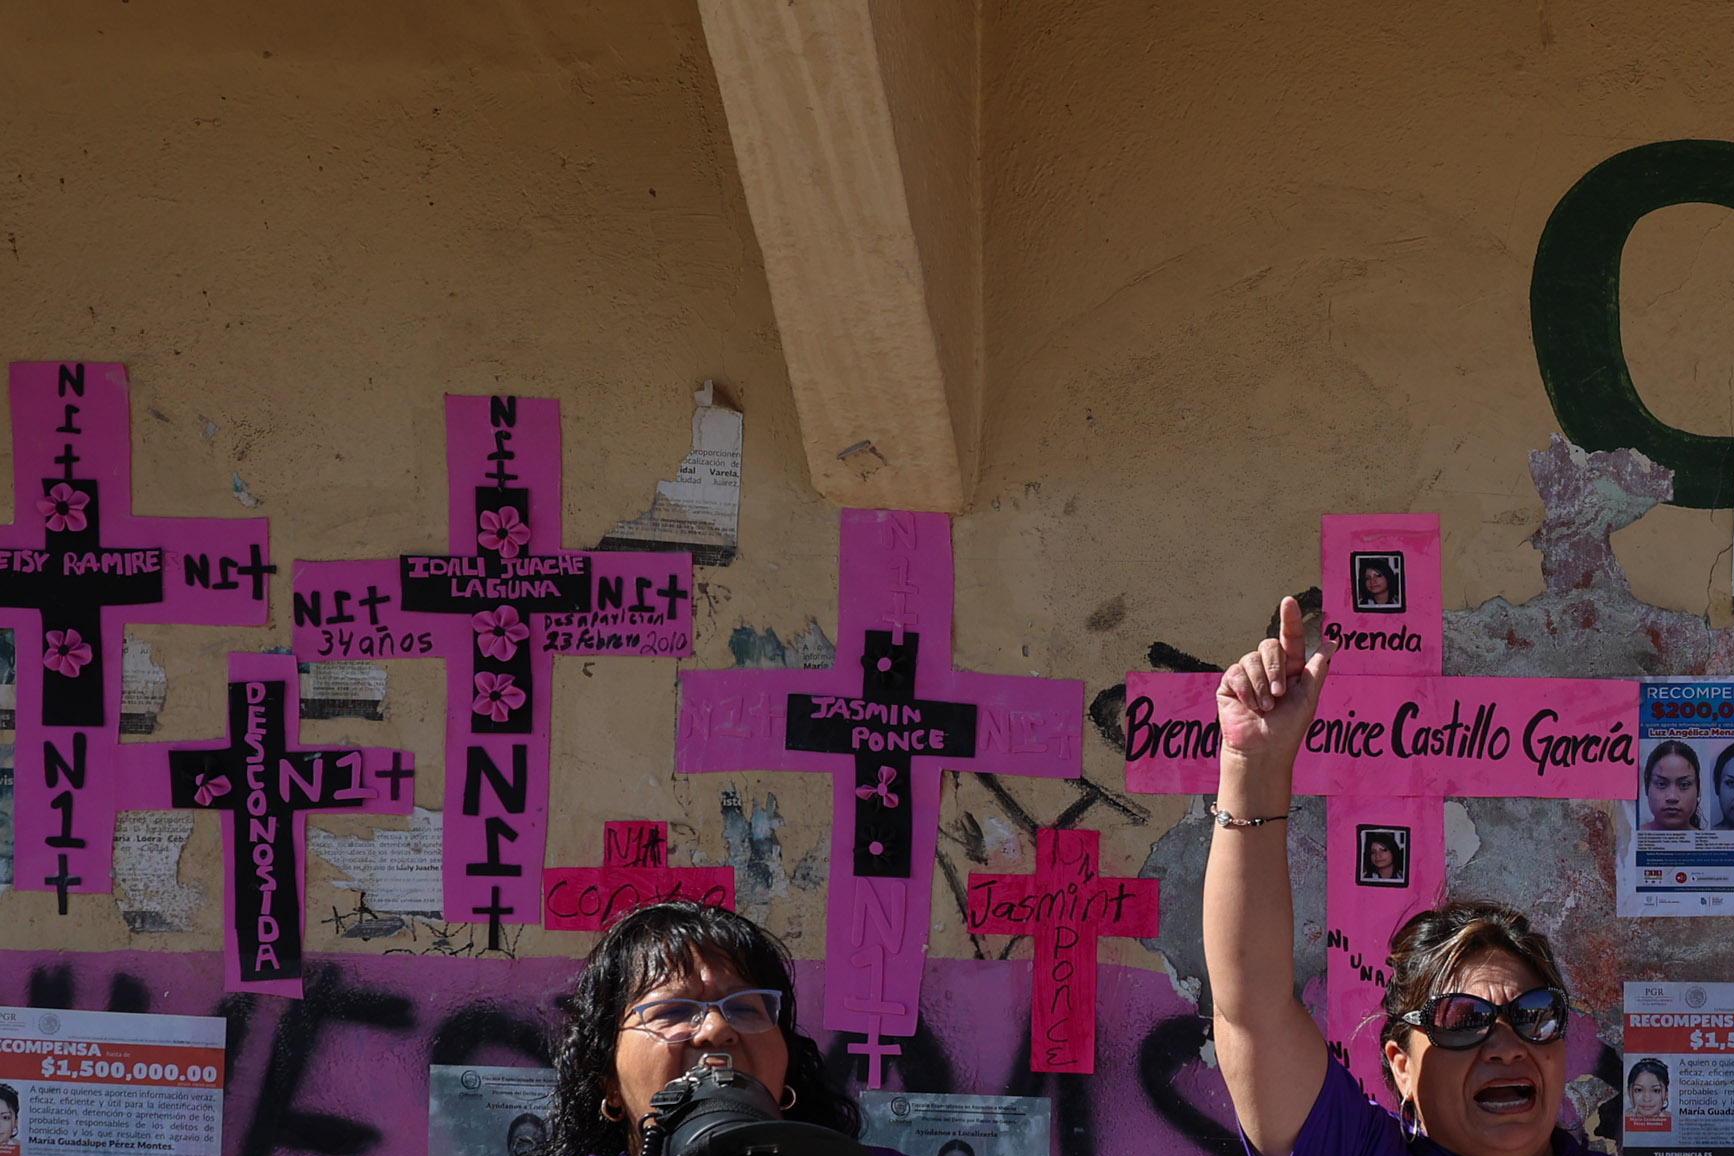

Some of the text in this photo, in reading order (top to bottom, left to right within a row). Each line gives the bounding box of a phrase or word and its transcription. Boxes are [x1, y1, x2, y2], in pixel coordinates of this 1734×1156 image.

[407, 556, 586, 578] IDALI JUACHE
[450, 578, 562, 600] LAGUNA
[1323, 622, 1423, 656] Brenda
[810, 696, 920, 725] JASMIN
[852, 727, 945, 751] PONCE
[1125, 696, 1221, 761] Brend
[1391, 699, 1510, 761] Castillo
[1523, 708, 1635, 776] García
[1649, 728, 1667, 738] Luz
[1668, 727, 1710, 738] Angélica
[1645, 988, 1664, 996] PGR
[41, 1056, 217, 1083] $1,500,000.00
[1679, 1059, 1686, 1067] A
[1688, 1059, 1709, 1068] quien
[1679, 1107, 1706, 1116] María
[28, 1136, 175, 1151] María Guadalupe Pérez Montes.
